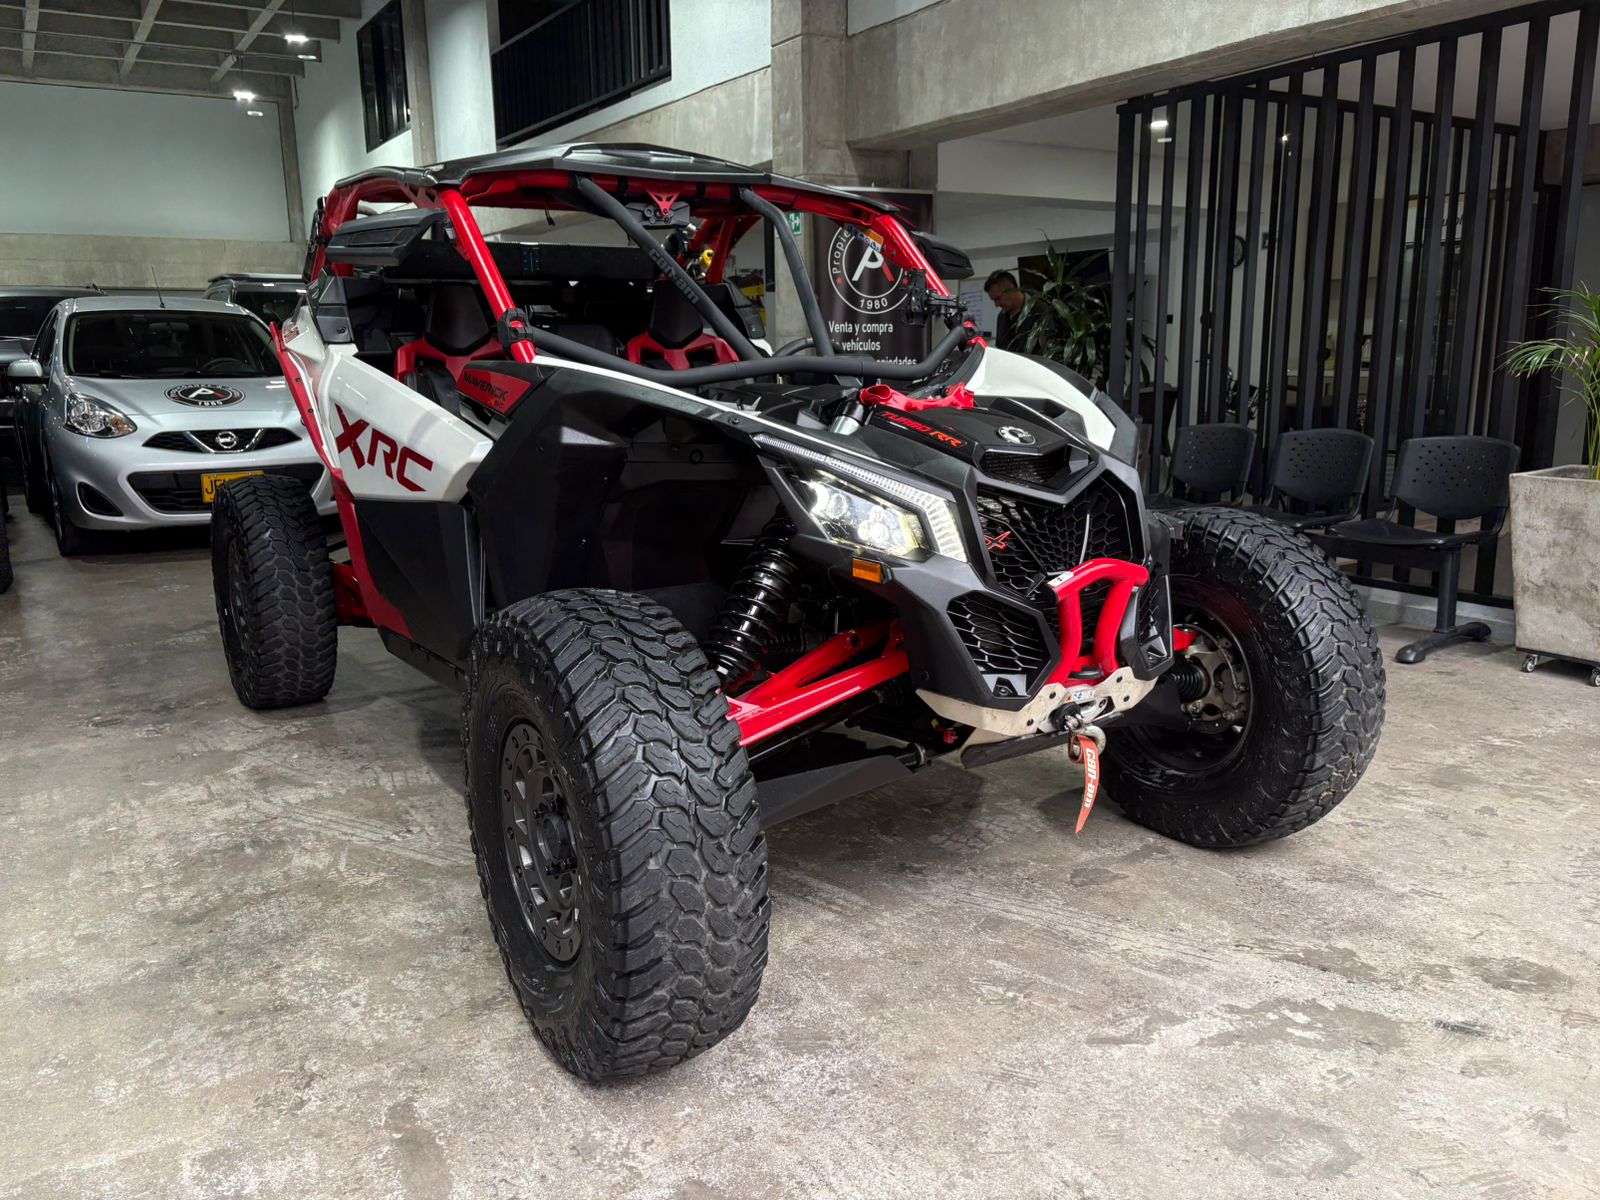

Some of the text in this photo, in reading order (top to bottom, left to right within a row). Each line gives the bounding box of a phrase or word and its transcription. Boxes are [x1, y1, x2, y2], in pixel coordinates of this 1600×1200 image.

[832, 230, 851, 274] Propie
[860, 298, 888, 310] 1980
[828, 321, 894, 336] Venta y compra
[841, 337, 881, 351] vehículos
[463, 371, 509, 402] MAVERICK
[881, 411, 963, 447] TURBO RR
[335, 403, 434, 492] XRC
